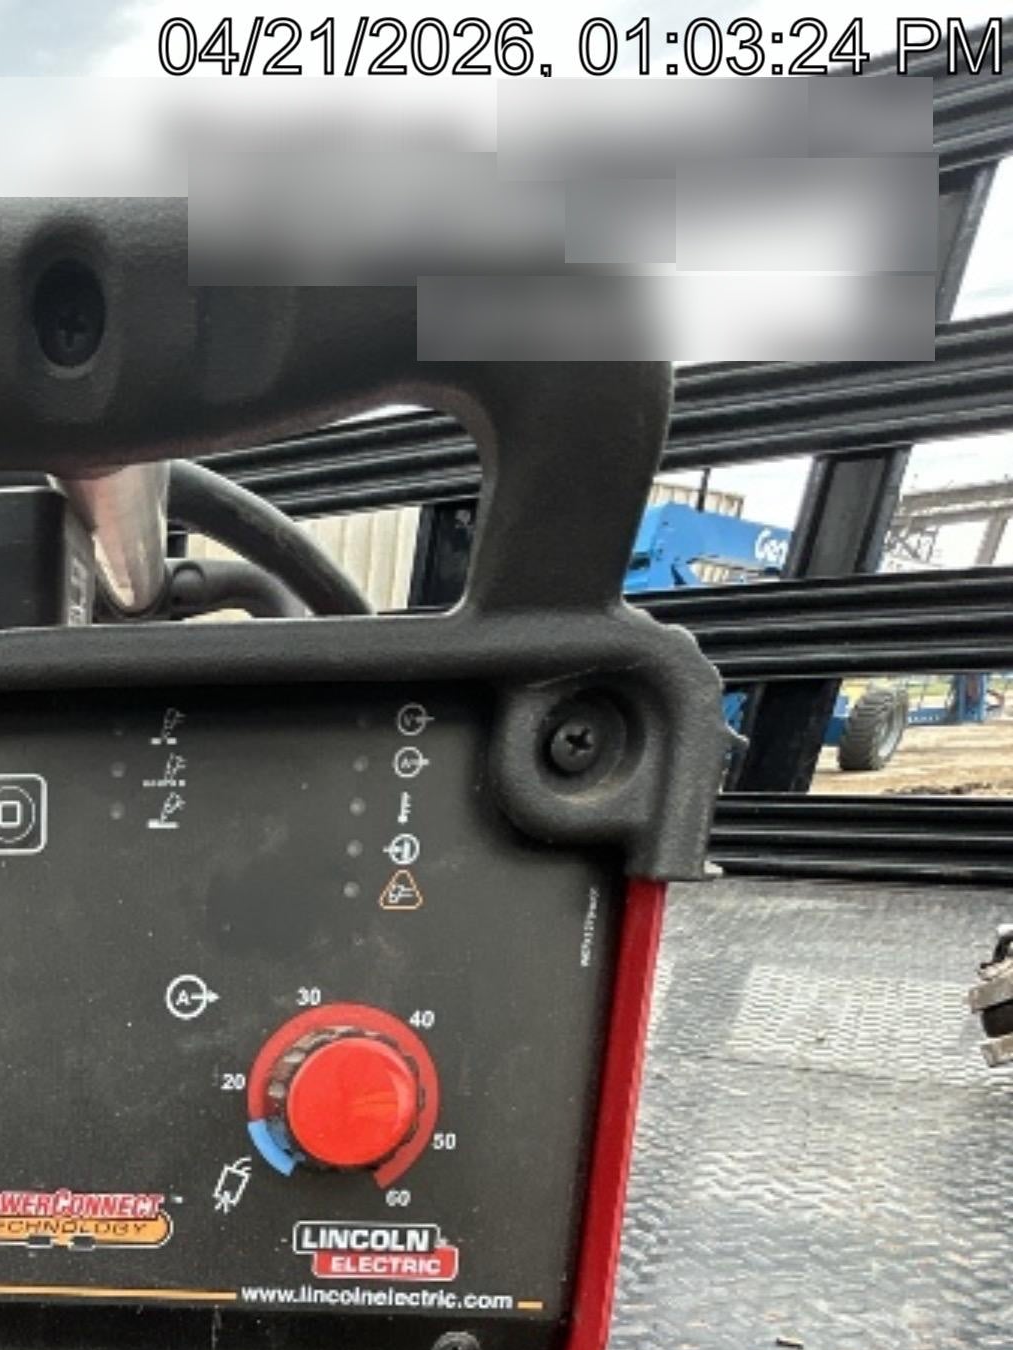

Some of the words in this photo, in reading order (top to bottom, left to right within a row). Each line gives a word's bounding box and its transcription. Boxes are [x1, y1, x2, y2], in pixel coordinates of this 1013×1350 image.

[296, 987, 322, 1007] 30
[409, 1010, 435, 1029] 40
[220, 1073, 246, 1091] 20
[432, 1133, 457, 1150] 50
[385, 1190, 411, 1207] 60
[300, 1227, 431, 1253] LINCOLN
[329, 1255, 441, 1274] ELECTRIC
[241, 1284, 515, 1311] www.lincolnelectric.com
